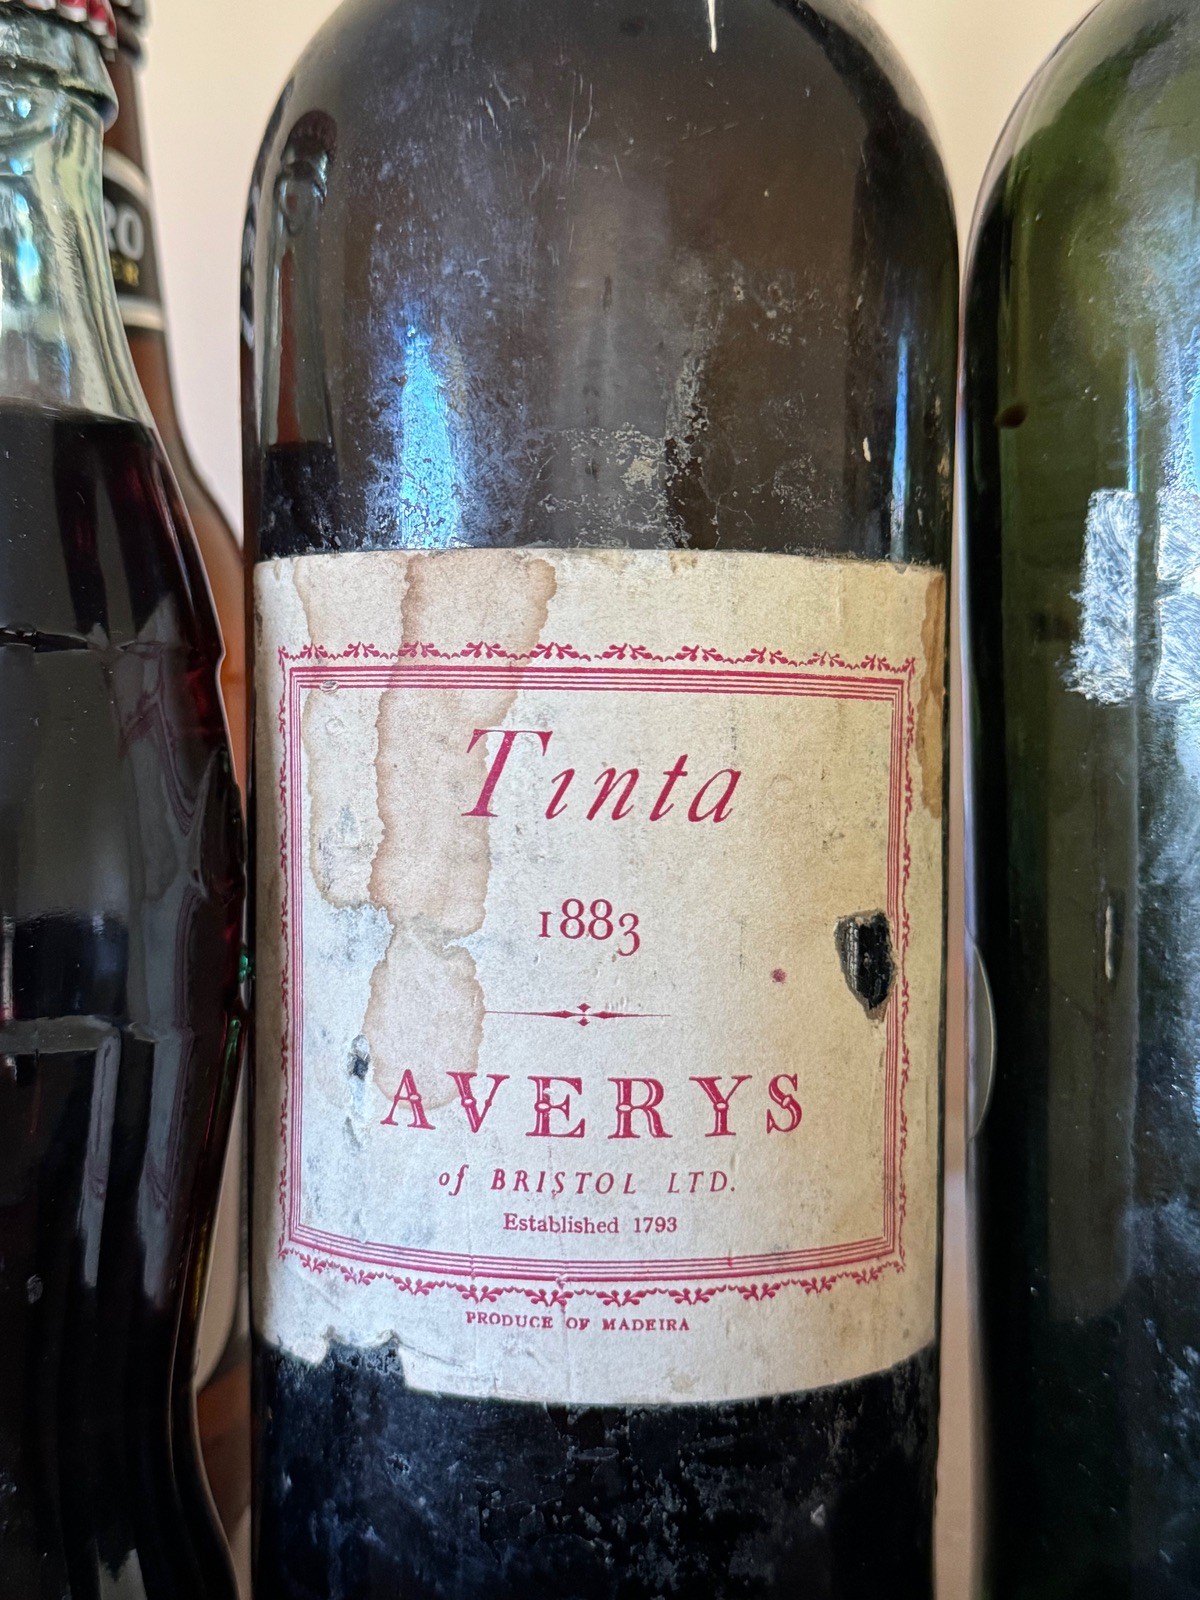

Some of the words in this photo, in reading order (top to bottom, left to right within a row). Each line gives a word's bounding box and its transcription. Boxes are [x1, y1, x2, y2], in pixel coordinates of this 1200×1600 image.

[461, 728, 742, 823] Tinta
[538, 898, 641, 957] 1883
[380, 1069, 803, 1139] AVERYS
[438, 1164, 469, 1196] of
[490, 1168, 636, 1196] BRISTOL
[668, 1170, 736, 1194] LTD.
[503, 1213, 619, 1234] Established
[634, 1216, 678, 1233] 1793
[466, 1311, 554, 1330] PRODUCE
[565, 1317, 590, 1331] OF
[602, 1319, 690, 1332] MADEIRA
